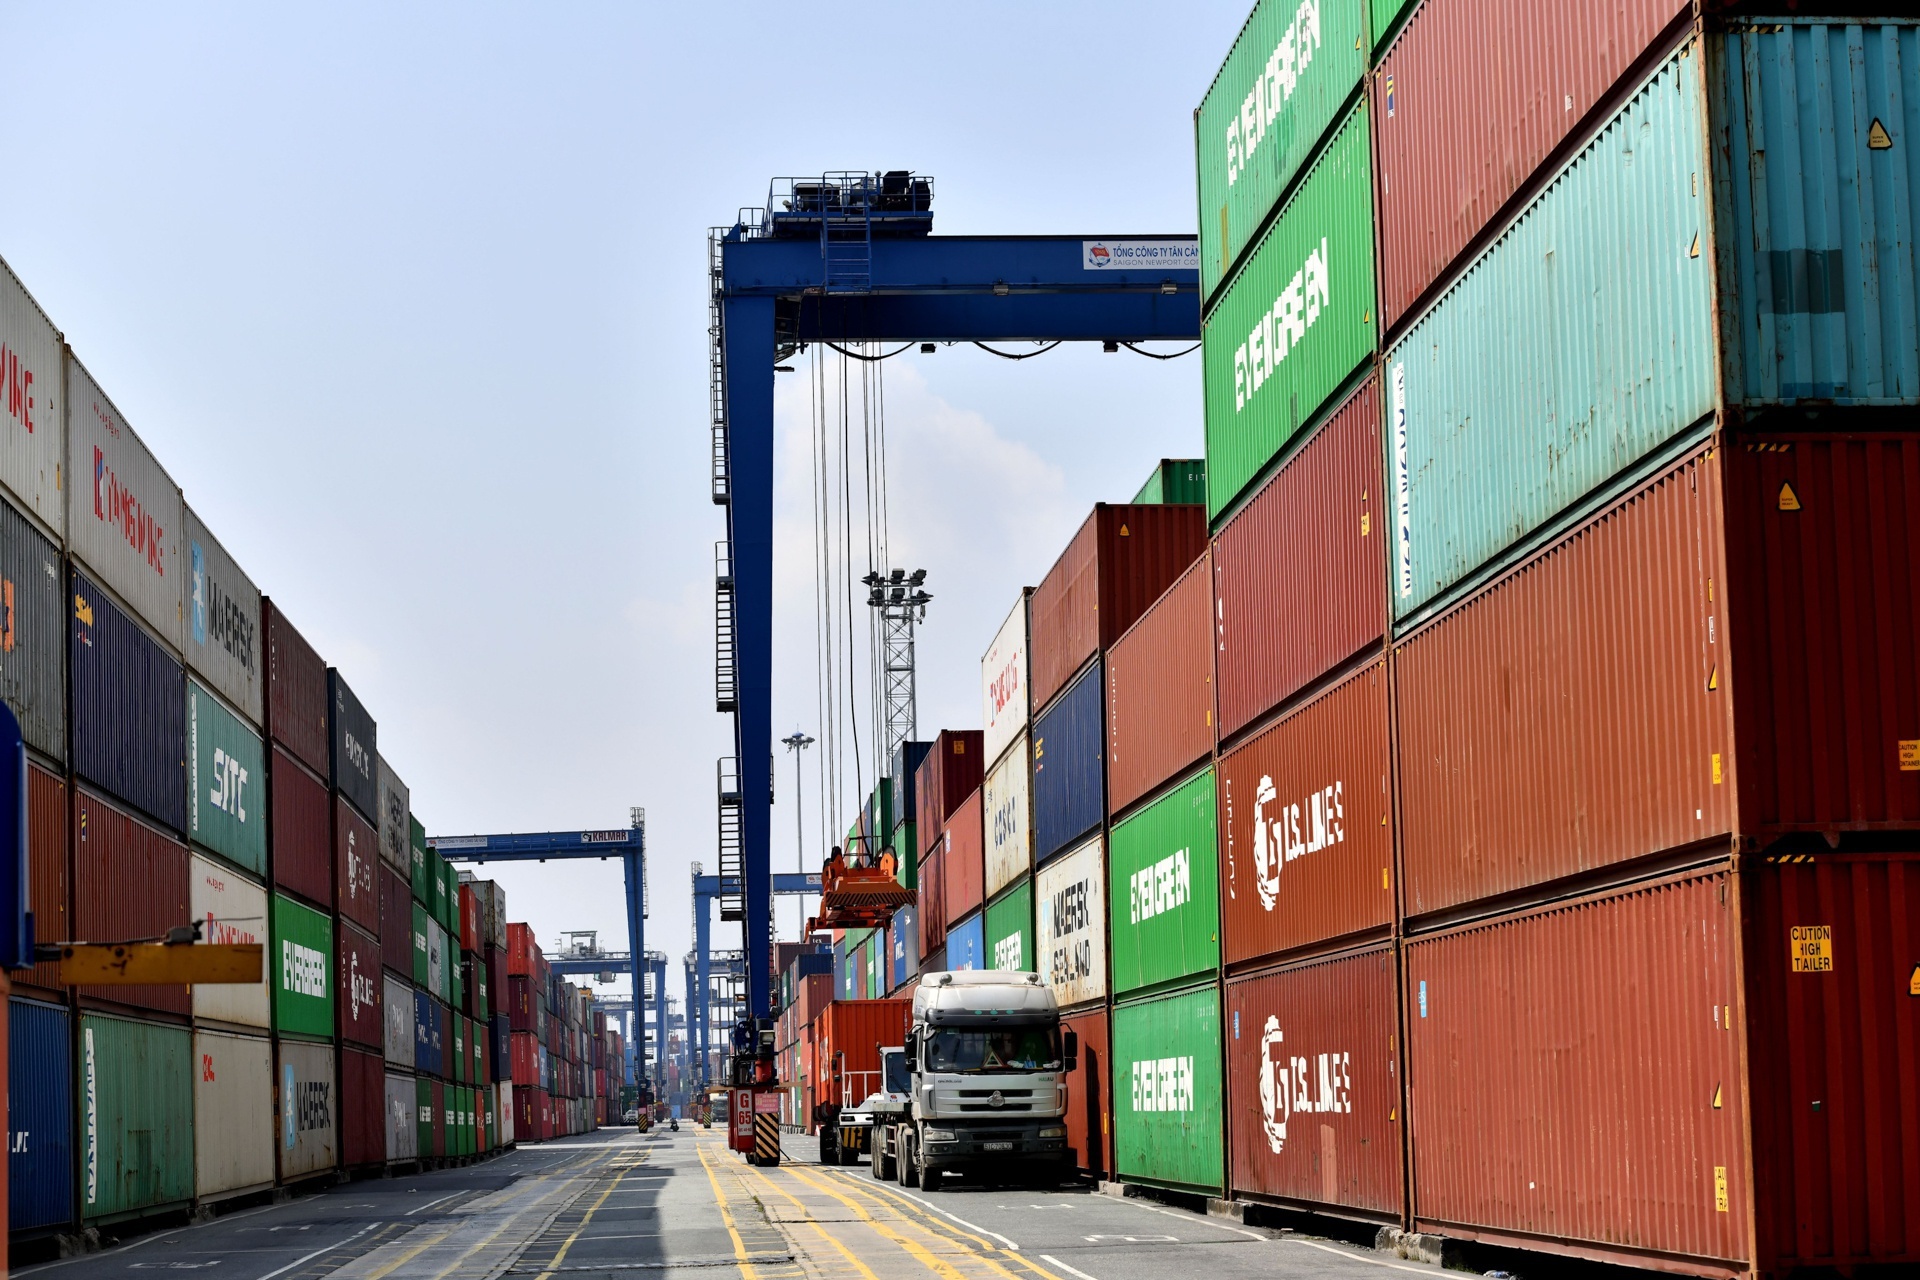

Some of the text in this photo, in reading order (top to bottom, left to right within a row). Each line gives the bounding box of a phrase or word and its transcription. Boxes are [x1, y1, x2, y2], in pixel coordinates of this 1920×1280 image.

[1136, 246, 1158, 257] CÔNG
[1160, 247, 1168, 257] TY
[1169, 246, 1182, 257] TÂN
[1235, 237, 1329, 414] EVERGREEN
[210, 747, 248, 823] SITC
[593, 832, 626, 841] KALMAR
[1130, 846, 1190, 925] EVERGREEN
[1054, 878, 1089, 939] MAERSK
[1792, 928, 1829, 940] CUTION
[1795, 957, 1830, 970] TAILER
[740, 1093, 749, 1108] G
[1132, 1055, 1194, 1113] EVERGREEN
[1313, 1052, 1350, 1113] LINES
[738, 1111, 751, 1125] 65
